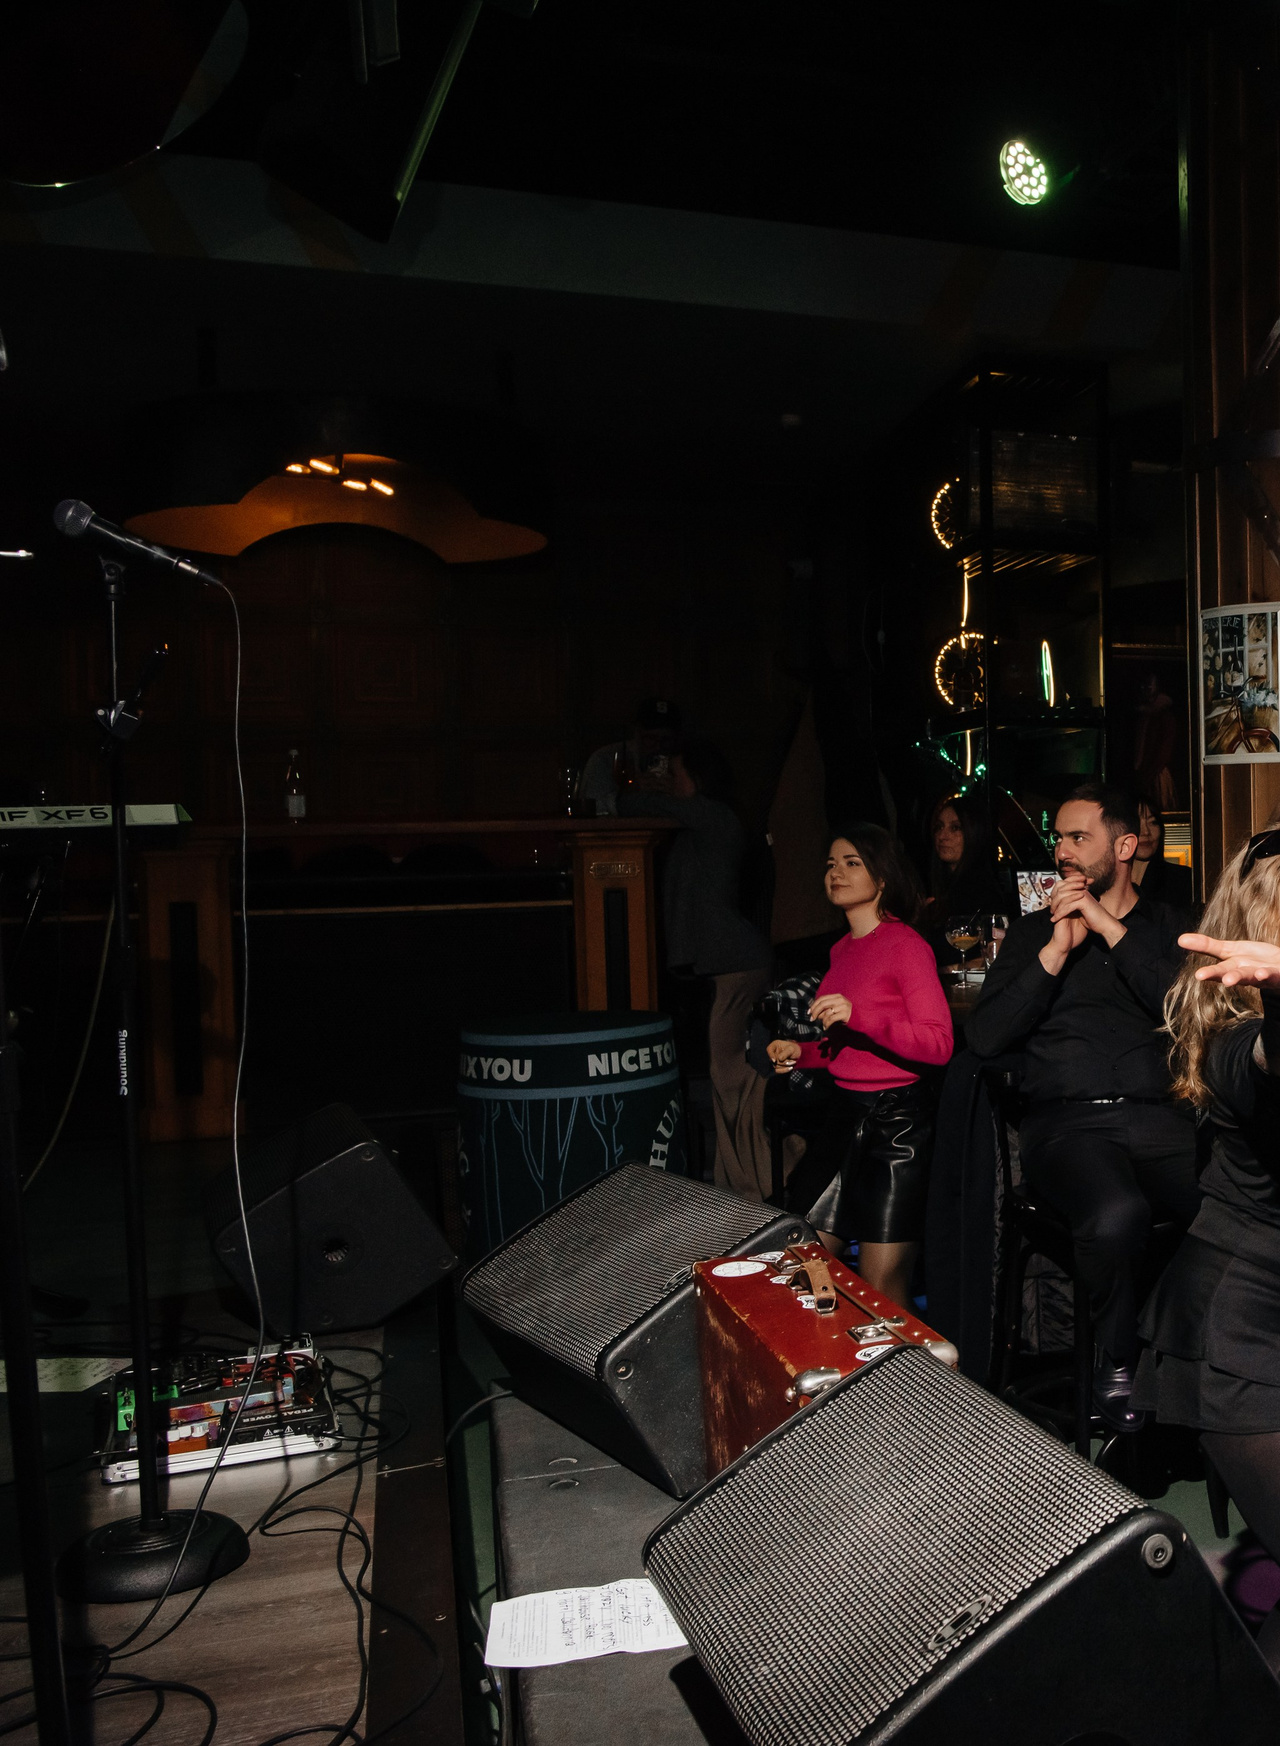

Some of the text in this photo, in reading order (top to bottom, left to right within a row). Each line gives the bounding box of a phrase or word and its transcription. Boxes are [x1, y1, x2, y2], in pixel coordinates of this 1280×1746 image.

[41, 807, 109, 821] XF6
[479, 1057, 532, 1082] YOU
[588, 1041, 673, 1077] NICE TO
